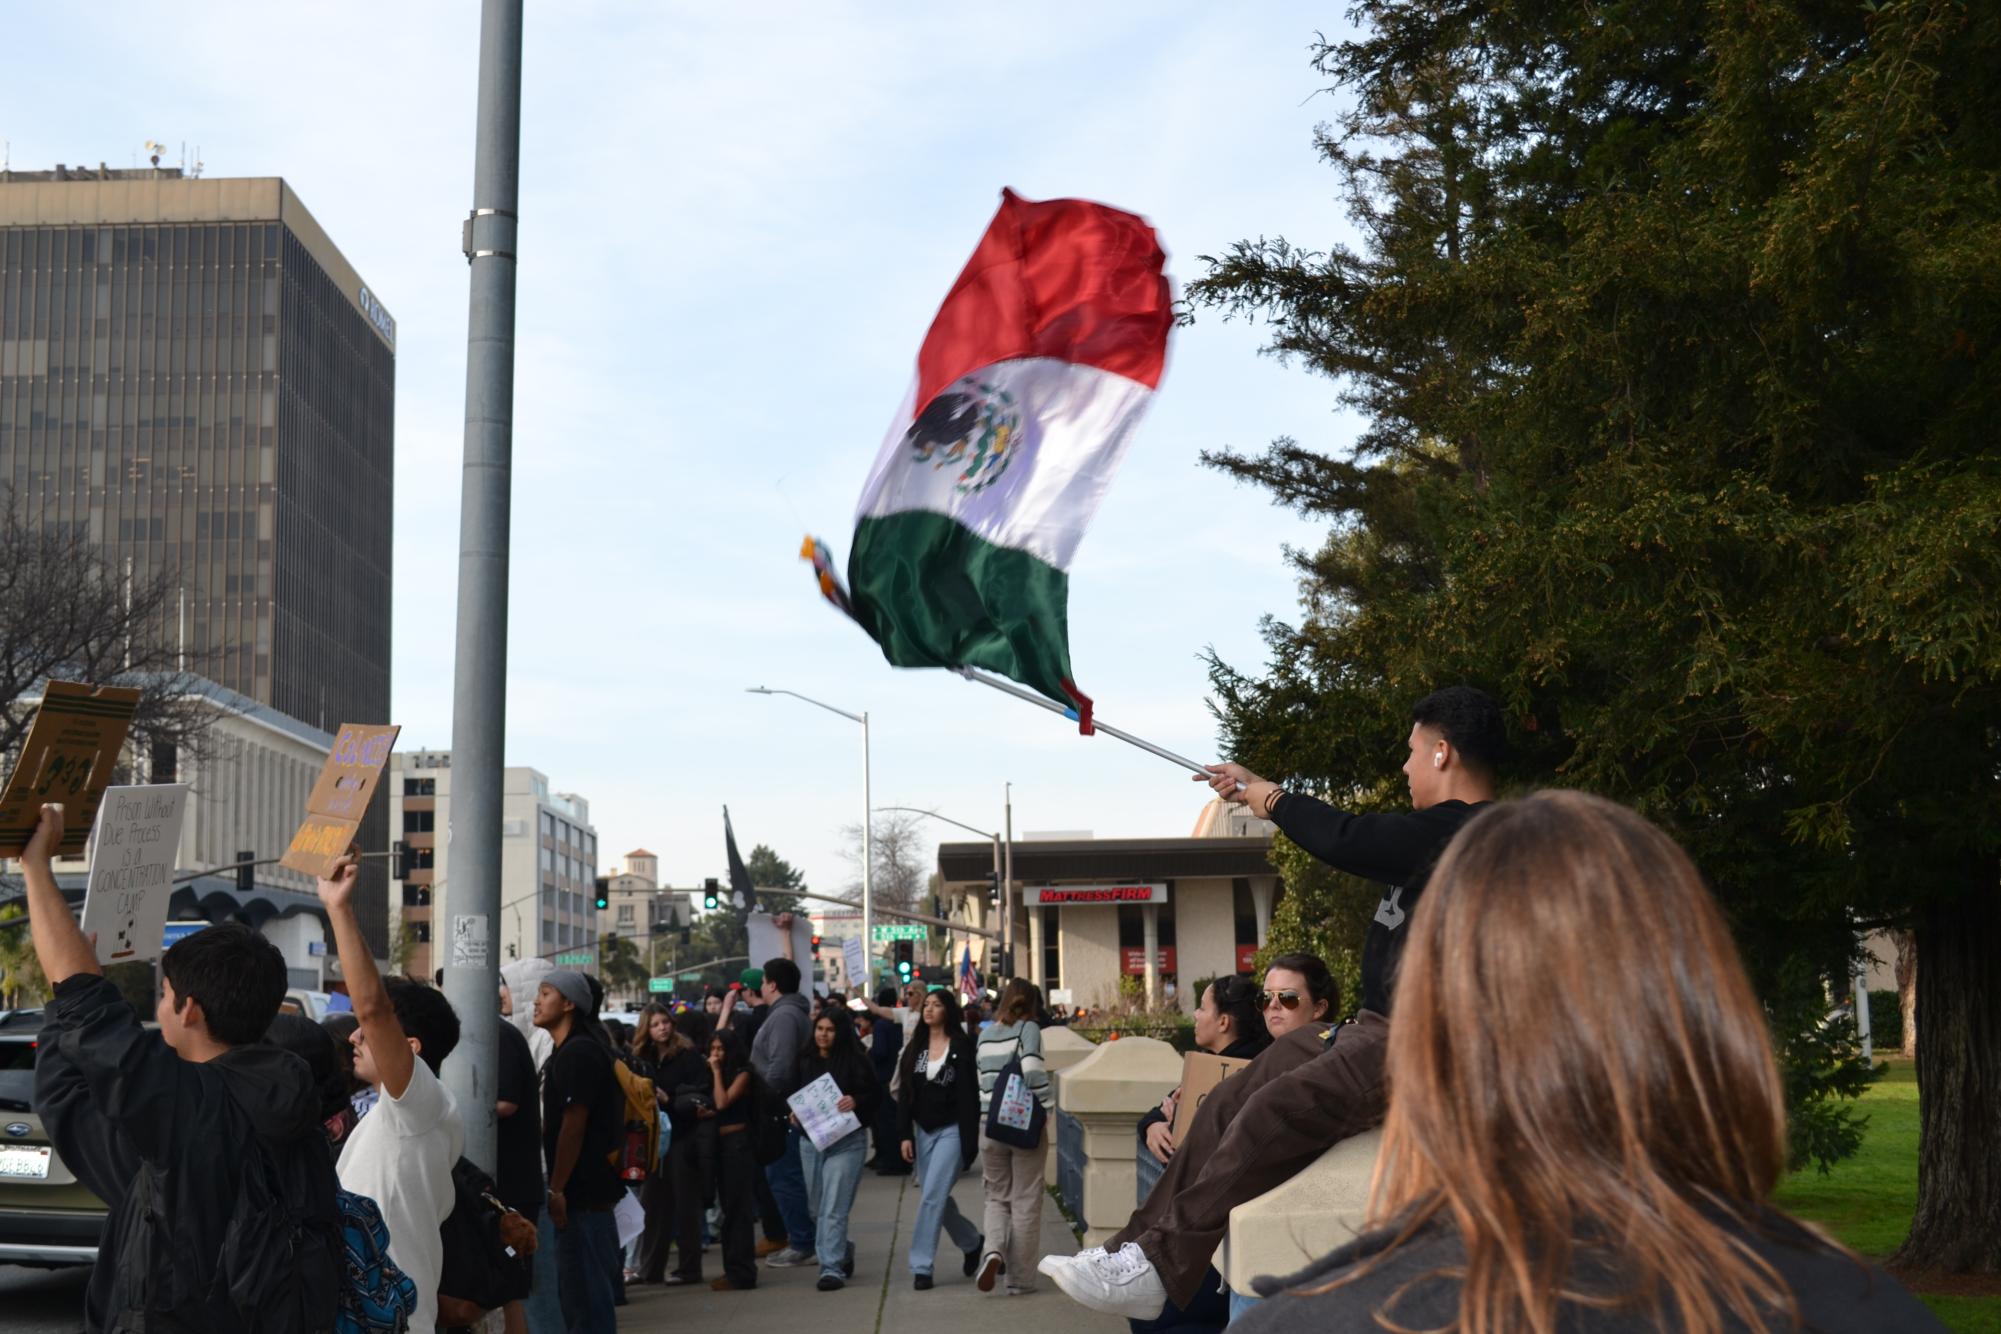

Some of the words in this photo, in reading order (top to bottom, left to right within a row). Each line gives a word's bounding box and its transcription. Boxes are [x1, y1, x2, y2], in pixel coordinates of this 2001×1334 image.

[103, 822, 124, 846] Due
[128, 822, 161, 845] Process
[96, 862, 168, 893] CONCENTRATION
[117, 889, 146, 915] CAMP
